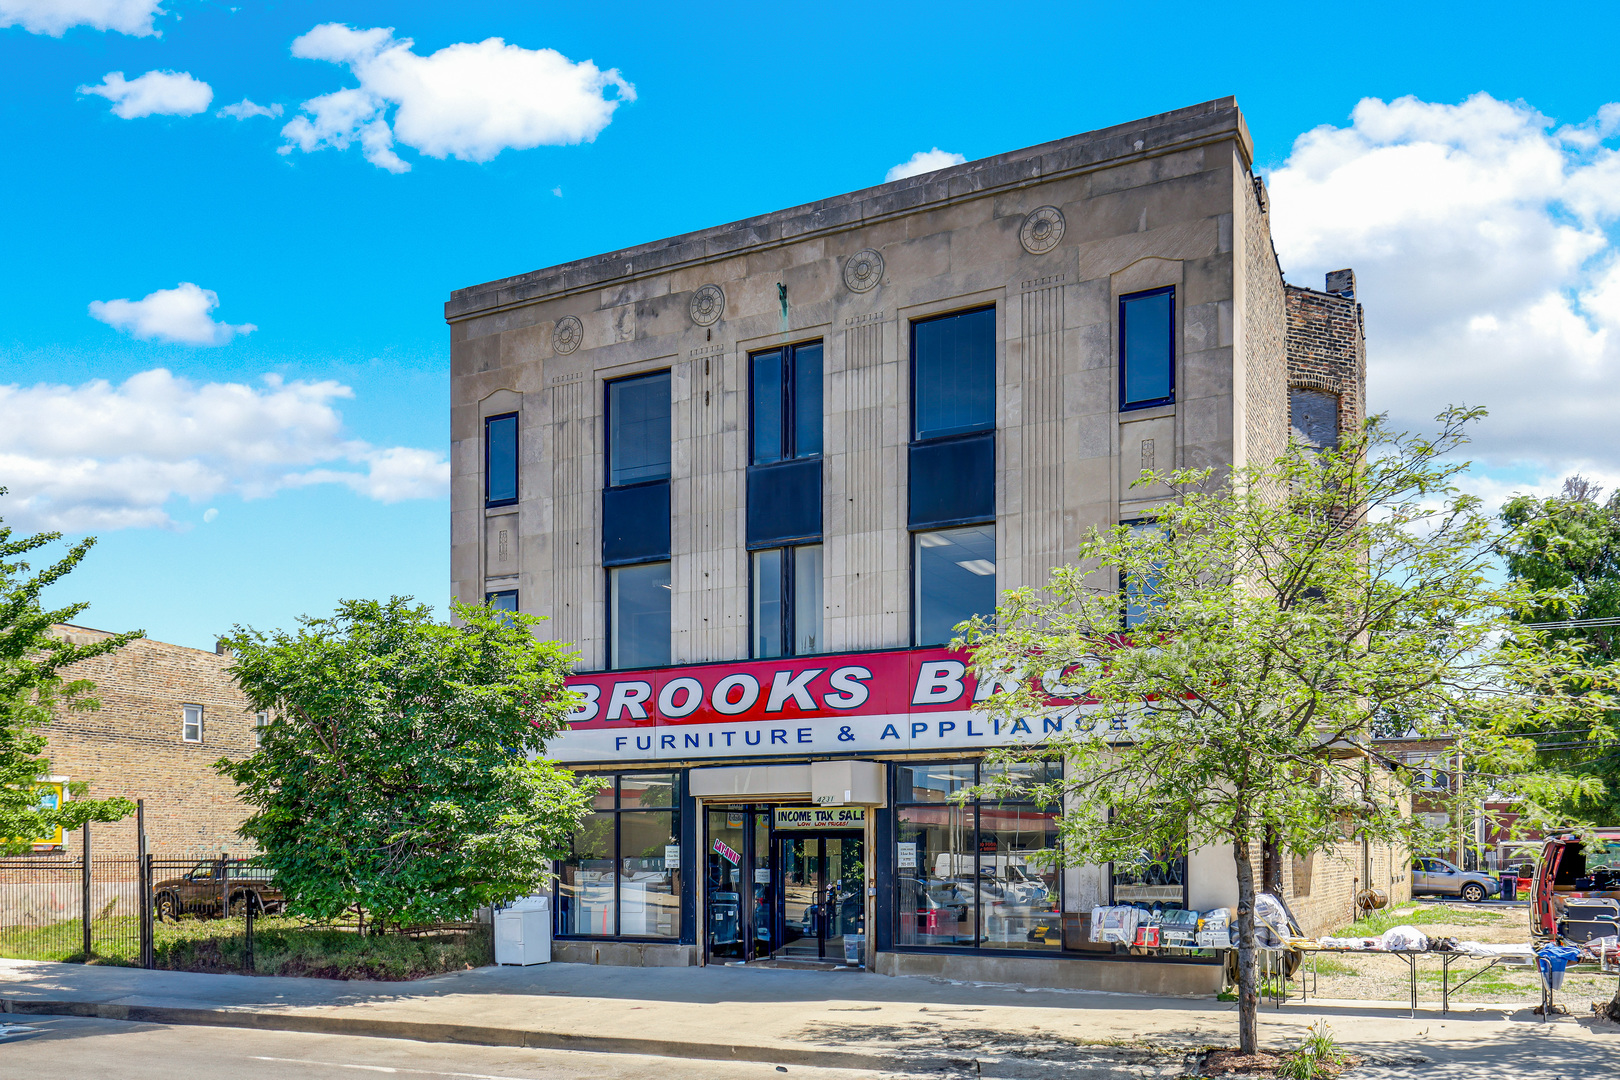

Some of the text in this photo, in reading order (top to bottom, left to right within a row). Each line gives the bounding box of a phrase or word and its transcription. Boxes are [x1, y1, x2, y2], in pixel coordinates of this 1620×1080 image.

[565, 647, 1172, 722] BROOKS BRO
[615, 712, 1158, 751] FURNITURE & APPLIANCE
[817, 795, 834, 803] 4231
[778, 811, 812, 822] INCOME
[815, 810, 833, 821] TAX
[713, 839, 741, 865] LAY-AWAY
